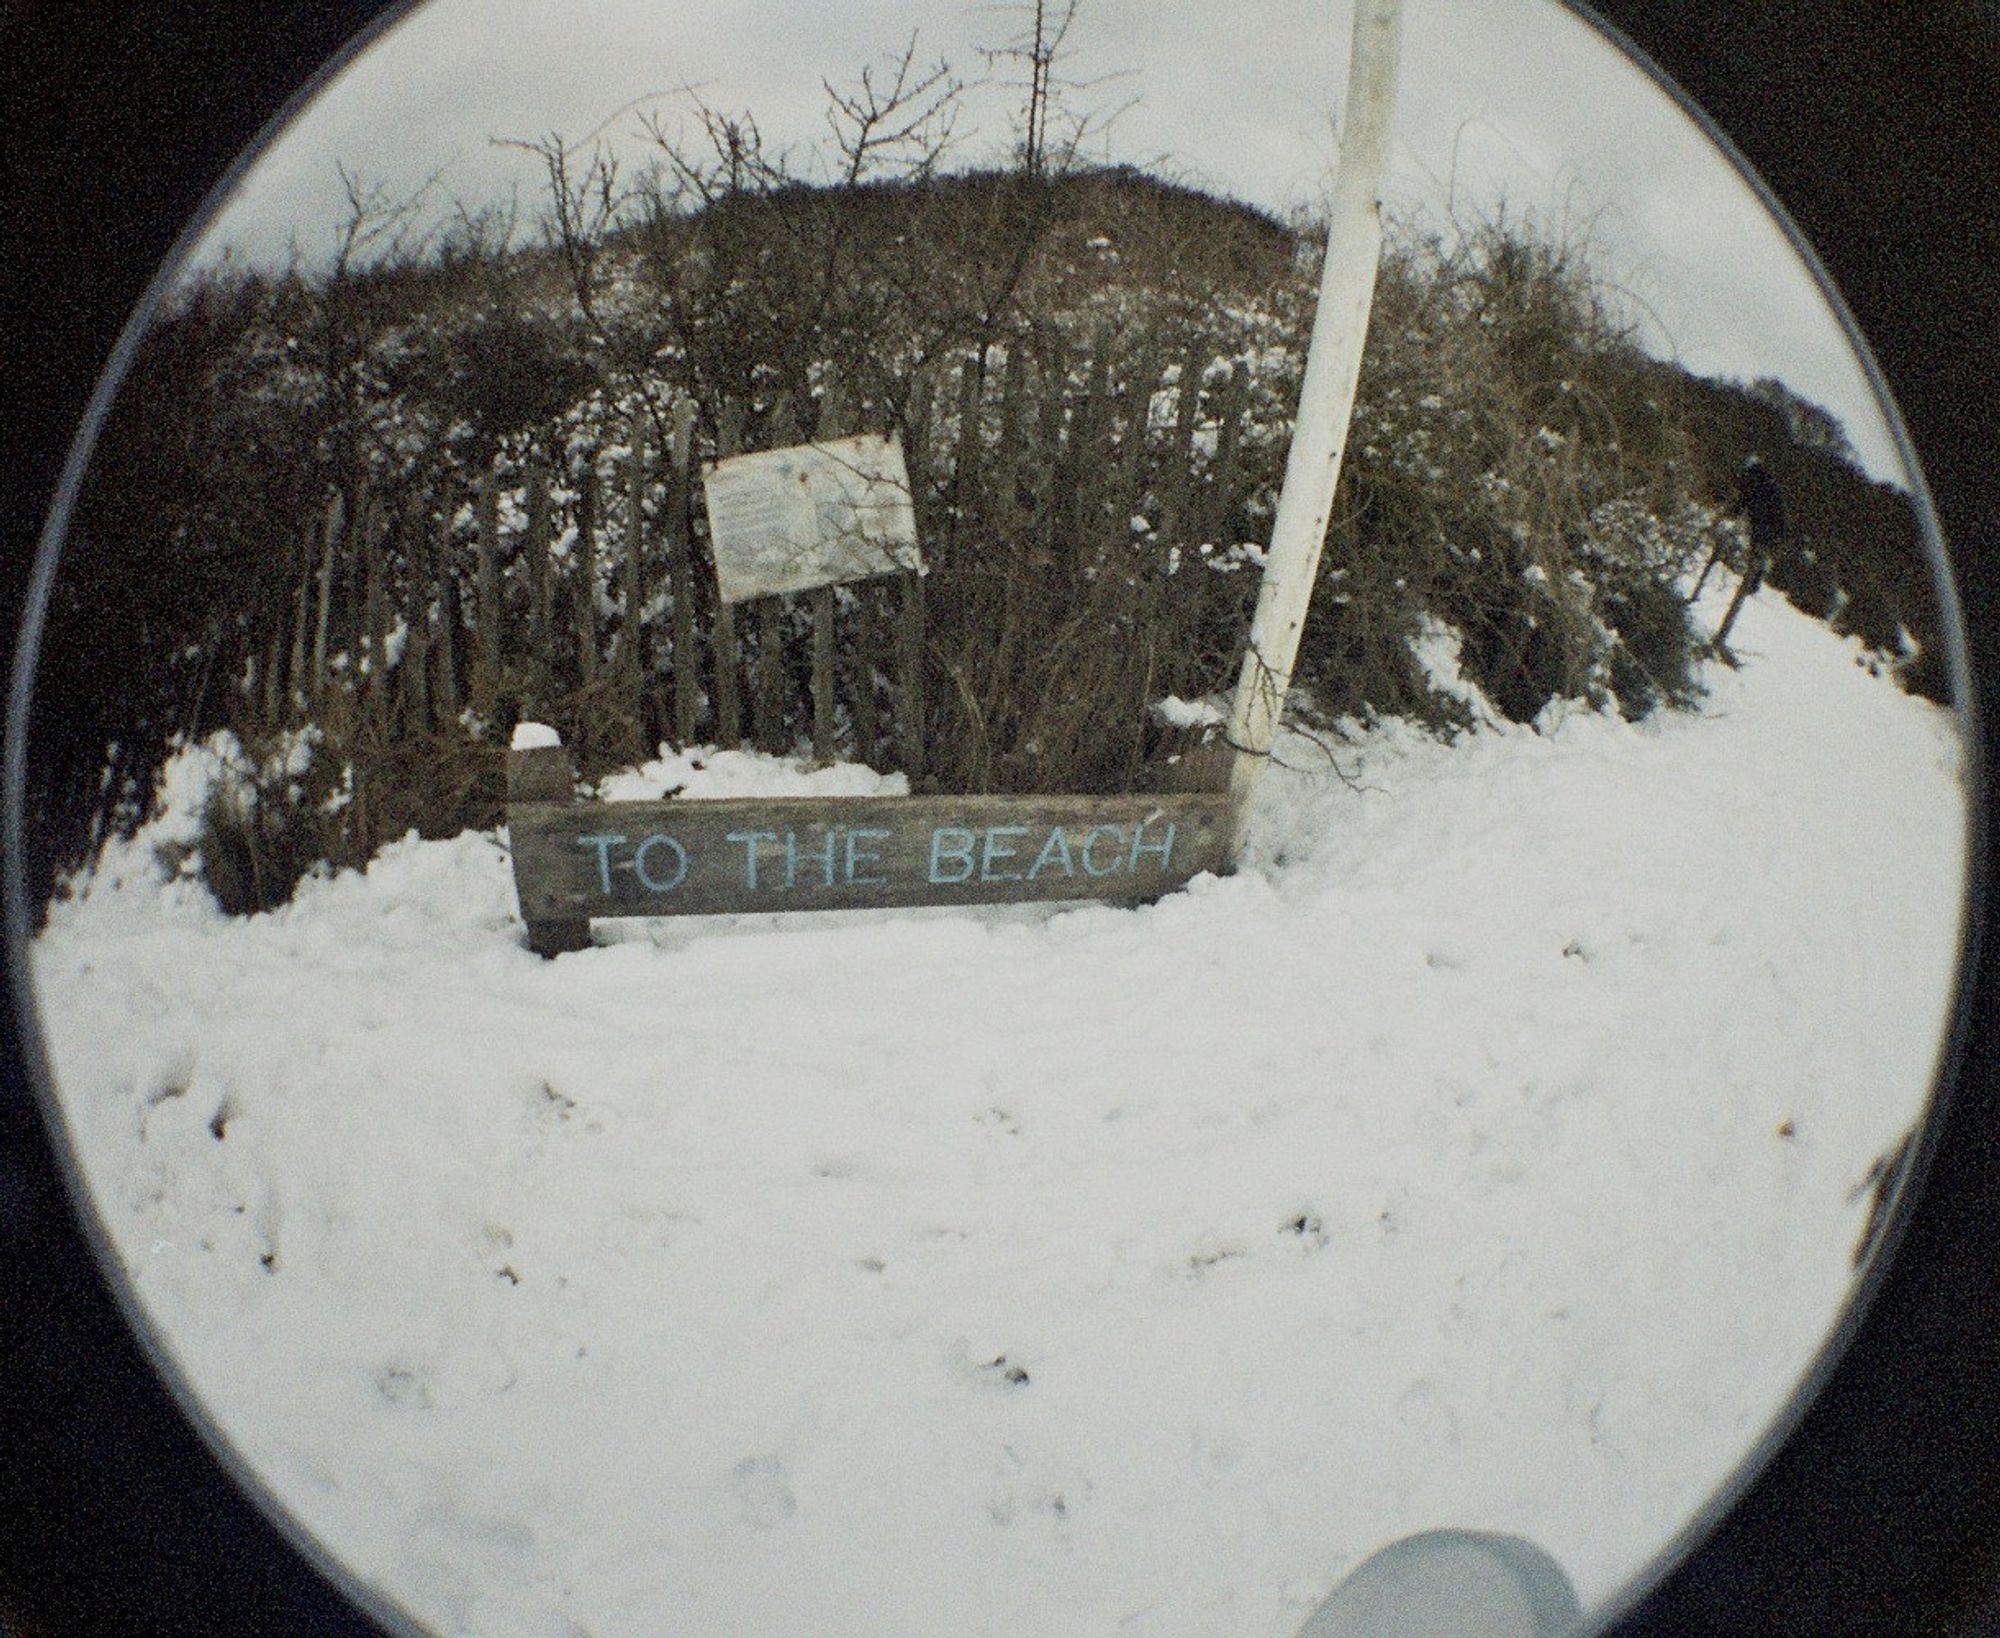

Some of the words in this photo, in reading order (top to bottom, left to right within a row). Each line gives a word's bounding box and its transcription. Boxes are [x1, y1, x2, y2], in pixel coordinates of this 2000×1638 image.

[576, 833, 689, 895] TO
[726, 828, 892, 890] THE
[927, 821, 1176, 884] BEACH
